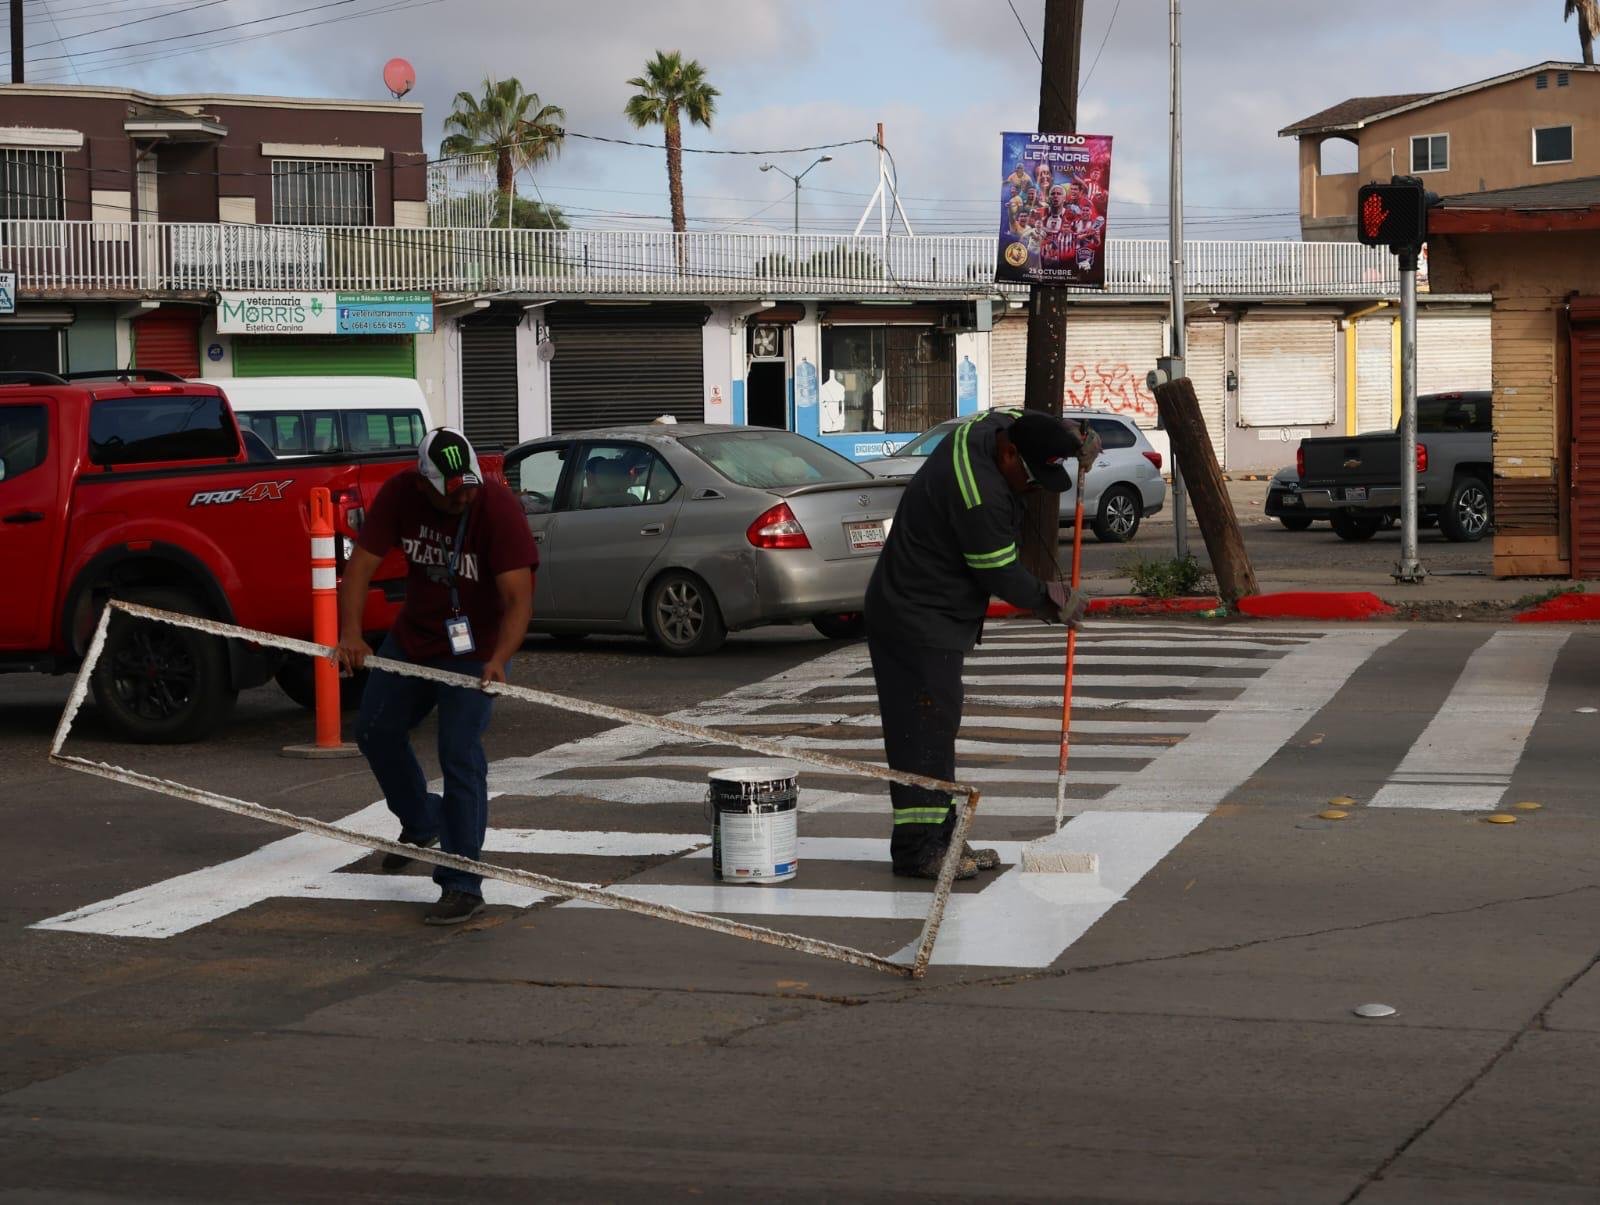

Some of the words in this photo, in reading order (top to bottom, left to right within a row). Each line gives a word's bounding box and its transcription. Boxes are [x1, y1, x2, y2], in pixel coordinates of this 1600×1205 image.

[1031, 134, 1086, 145] PARTIDO
[1024, 151, 1090, 163] LEYENDAS
[1038, 268, 1072, 276] OCTUBRE
[247, 296, 301, 306] veterinaria
[276, 323, 304, 331] Canina
